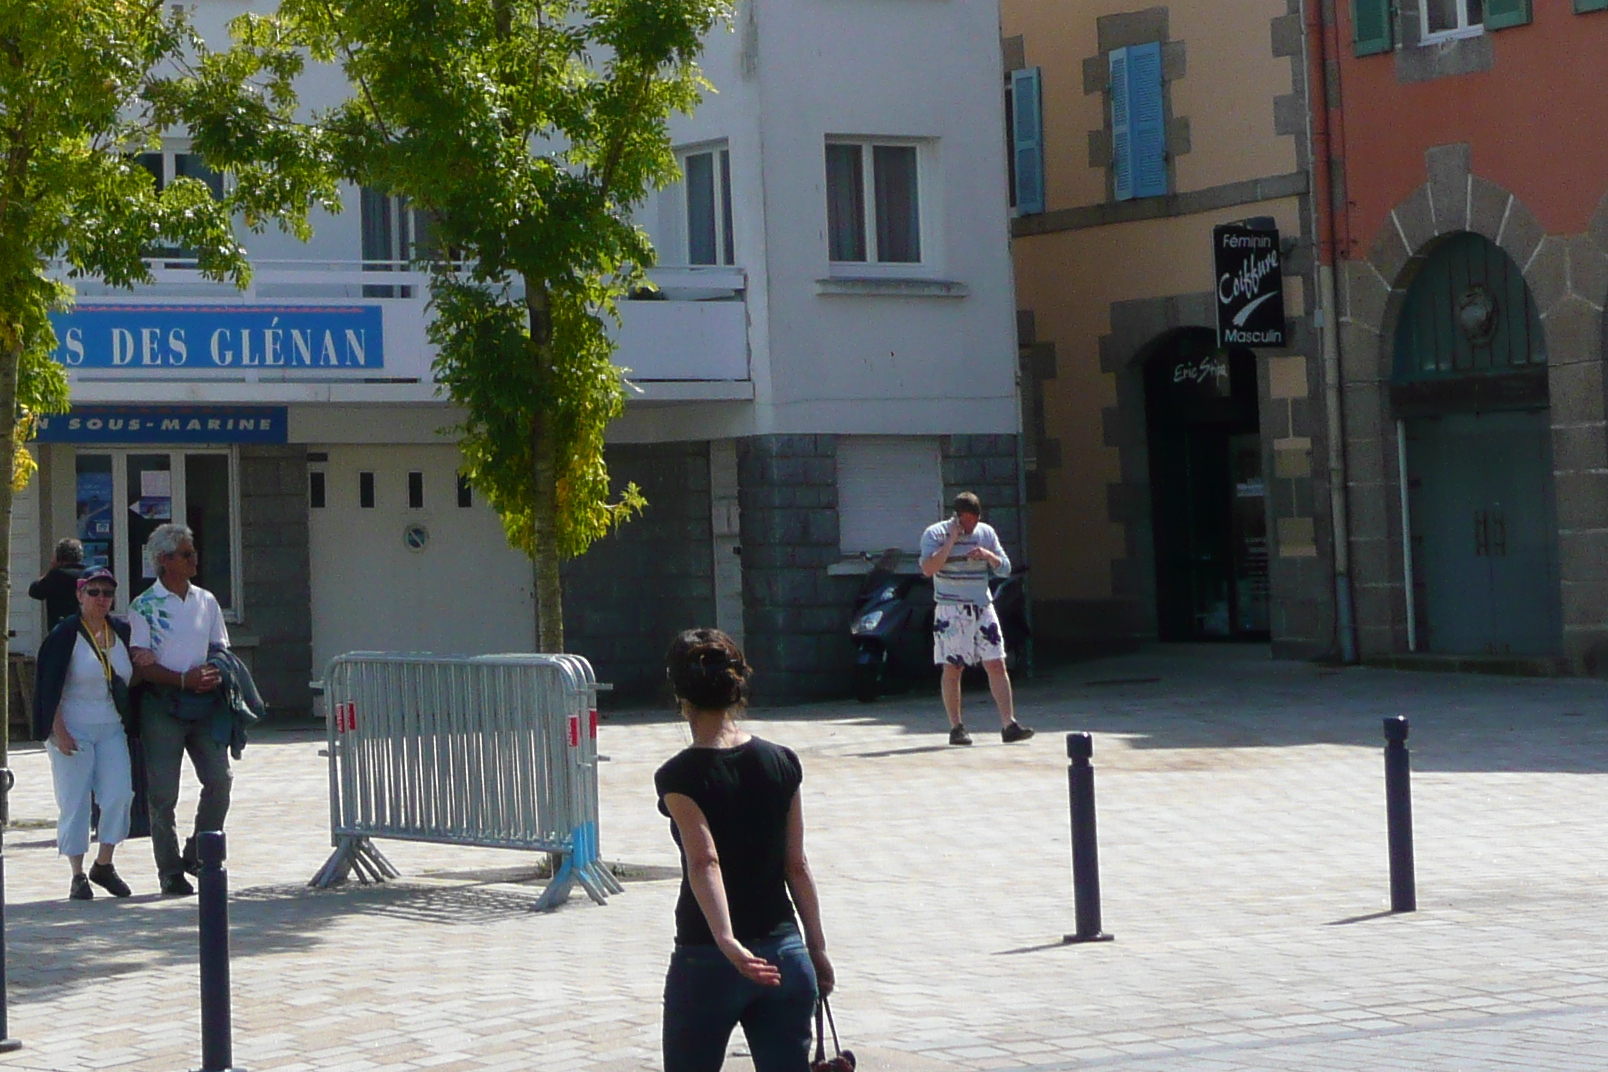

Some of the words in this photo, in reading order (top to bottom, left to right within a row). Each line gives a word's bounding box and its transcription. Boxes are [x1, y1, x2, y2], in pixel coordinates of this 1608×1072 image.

[1222, 234, 1271, 248] Féminin
[1218, 250, 1278, 304] Coiffure
[111, 328, 188, 365] DES
[210, 316, 366, 366] GLÉNAN
[1224, 329, 1282, 343] Masculin
[68, 418, 272, 431] SOUS-MARINE
